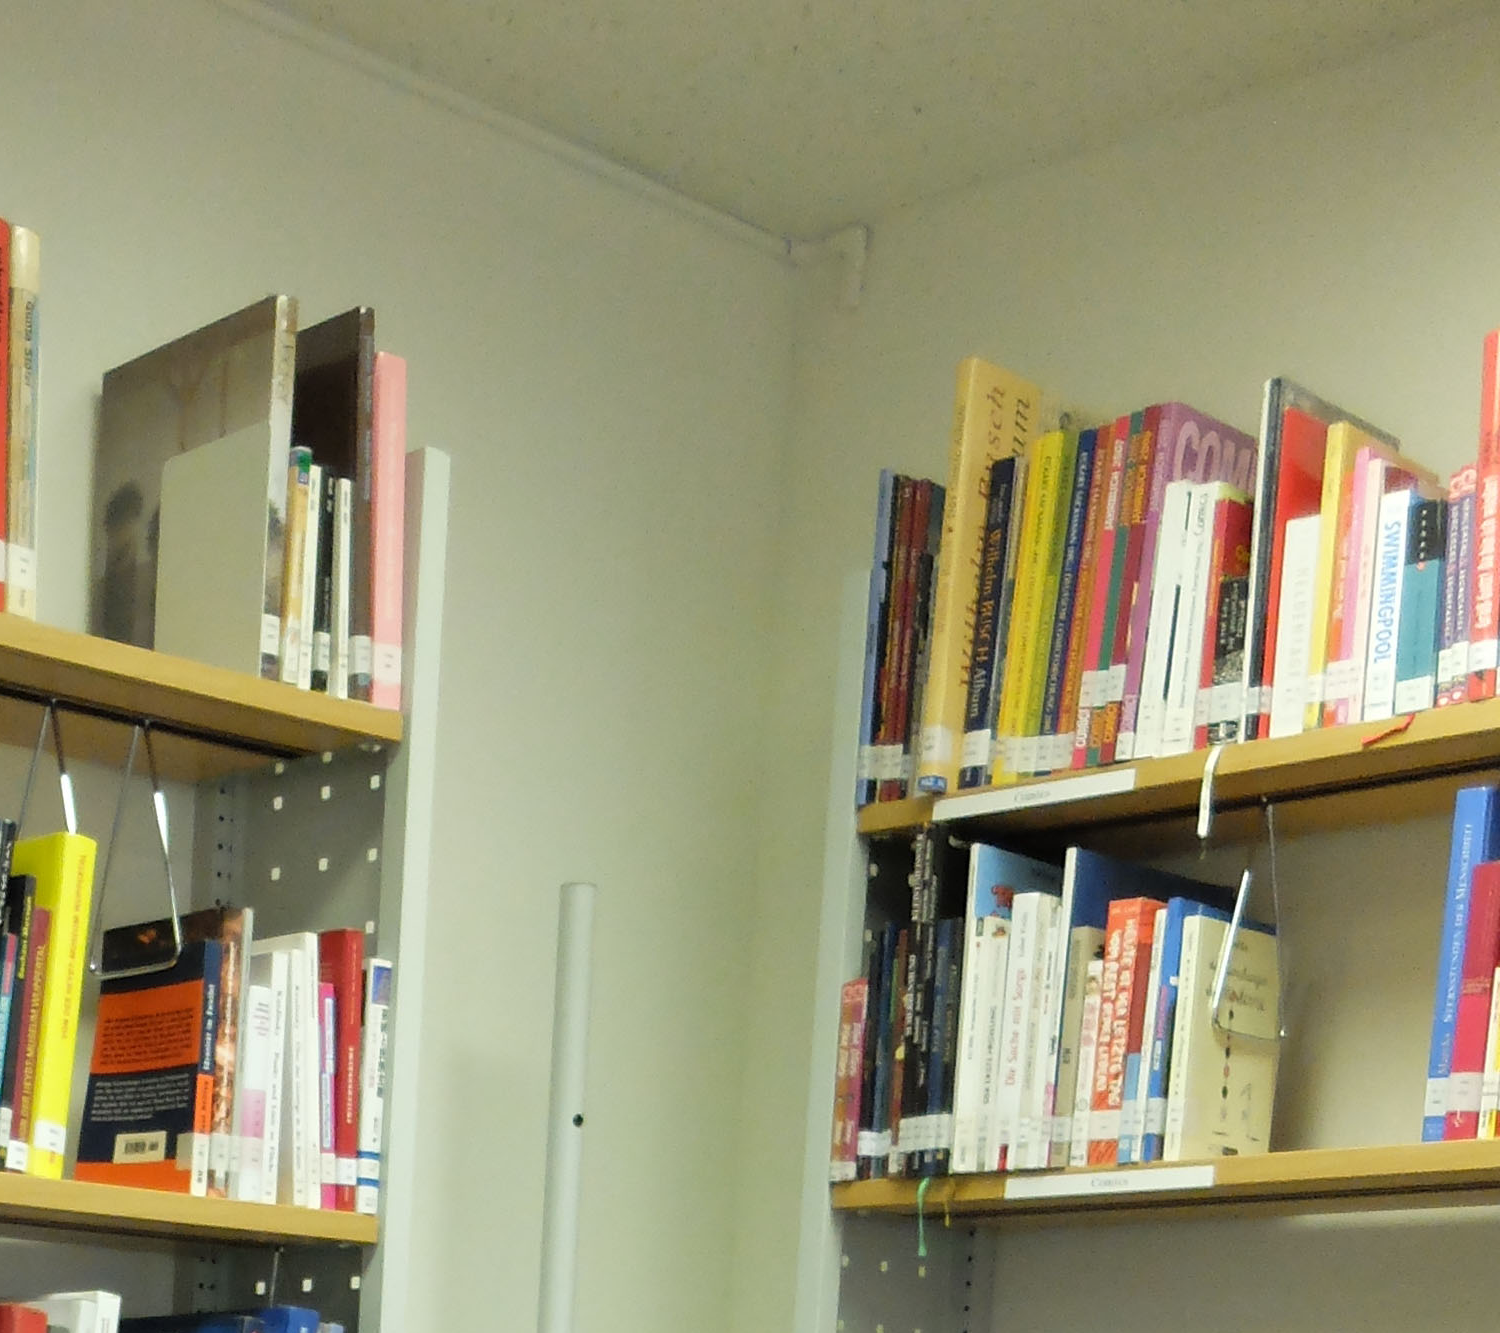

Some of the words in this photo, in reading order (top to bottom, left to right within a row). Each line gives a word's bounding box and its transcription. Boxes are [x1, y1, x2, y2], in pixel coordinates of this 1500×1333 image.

[982, 528, 1003, 595] Wilhelm
[1373, 520, 1402, 665] SWIMMINGPOOL
[969, 667, 987, 719] Album
[1011, 967, 1026, 1001] Sorge
[1006, 1031, 1020, 1064] Sache
